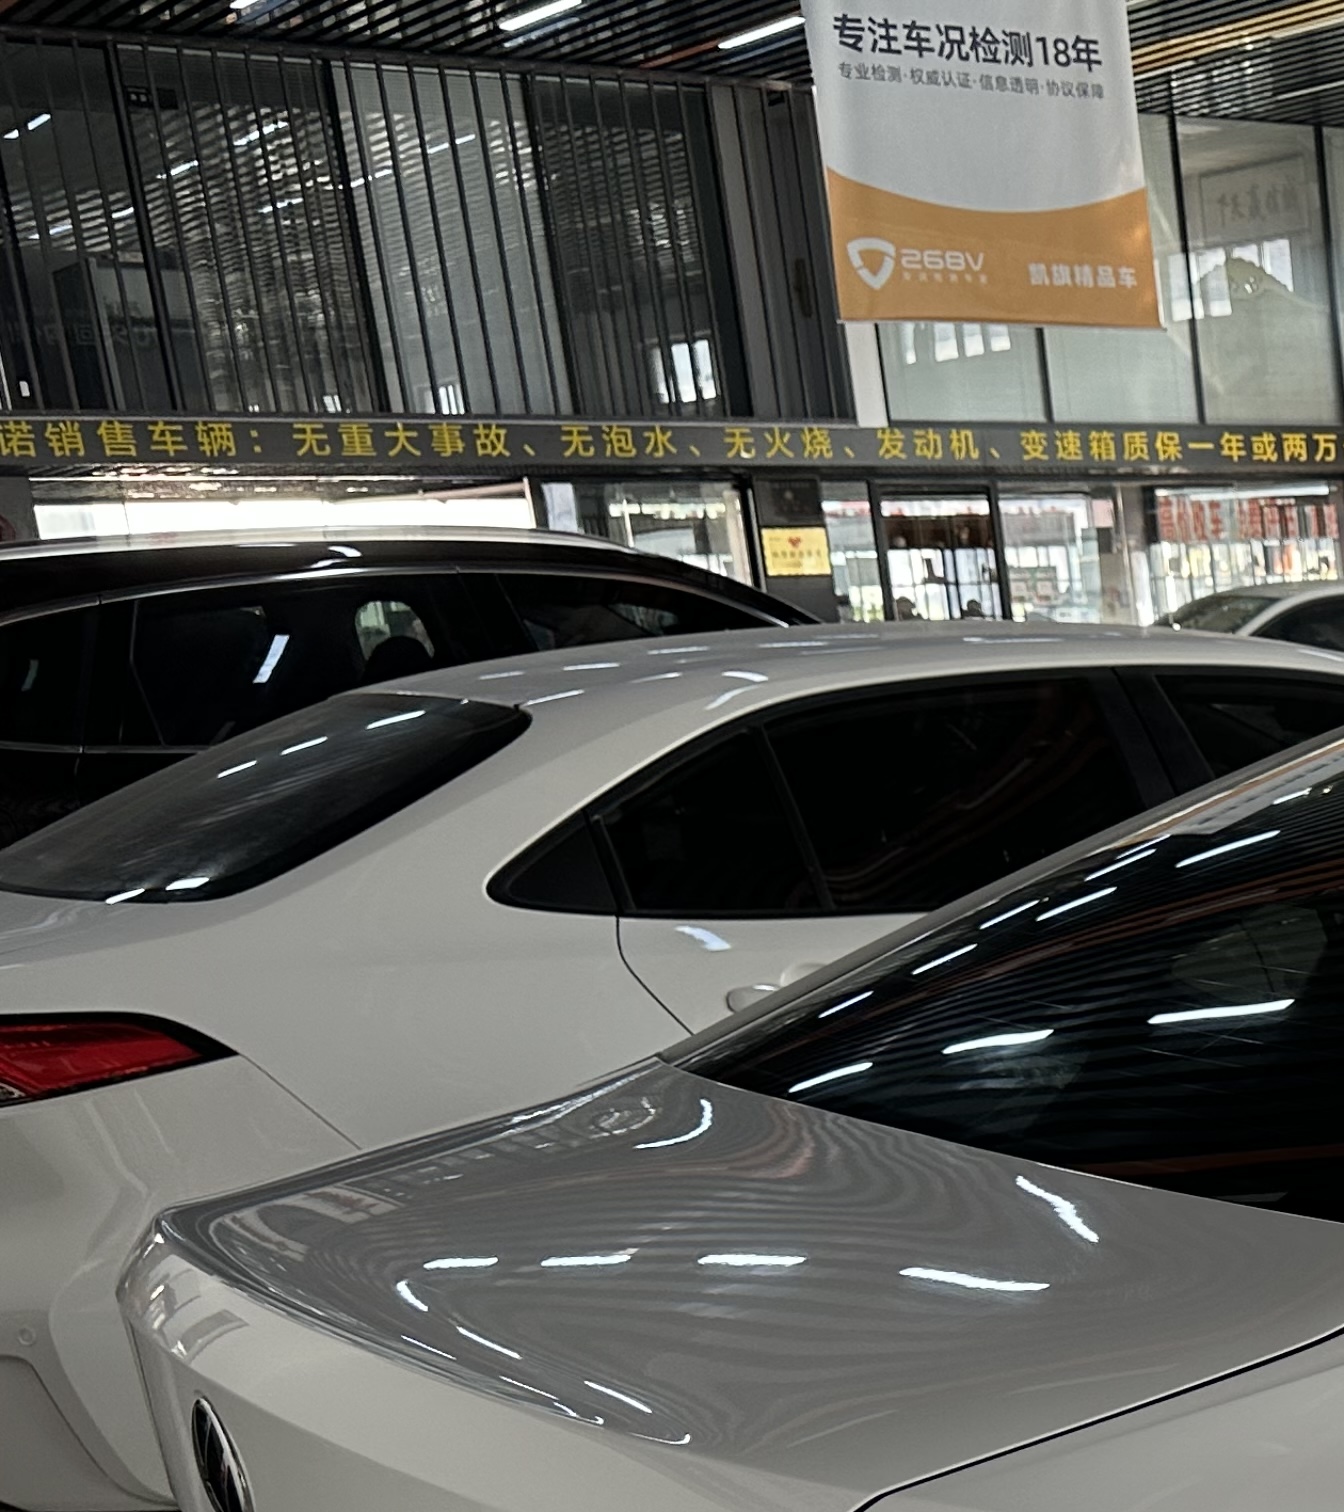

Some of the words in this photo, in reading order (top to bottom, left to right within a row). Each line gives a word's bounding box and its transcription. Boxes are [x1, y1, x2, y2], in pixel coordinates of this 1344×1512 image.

[832, 14, 1103, 72] 专注车况检测18年
[900, 248, 985, 272] 268V
